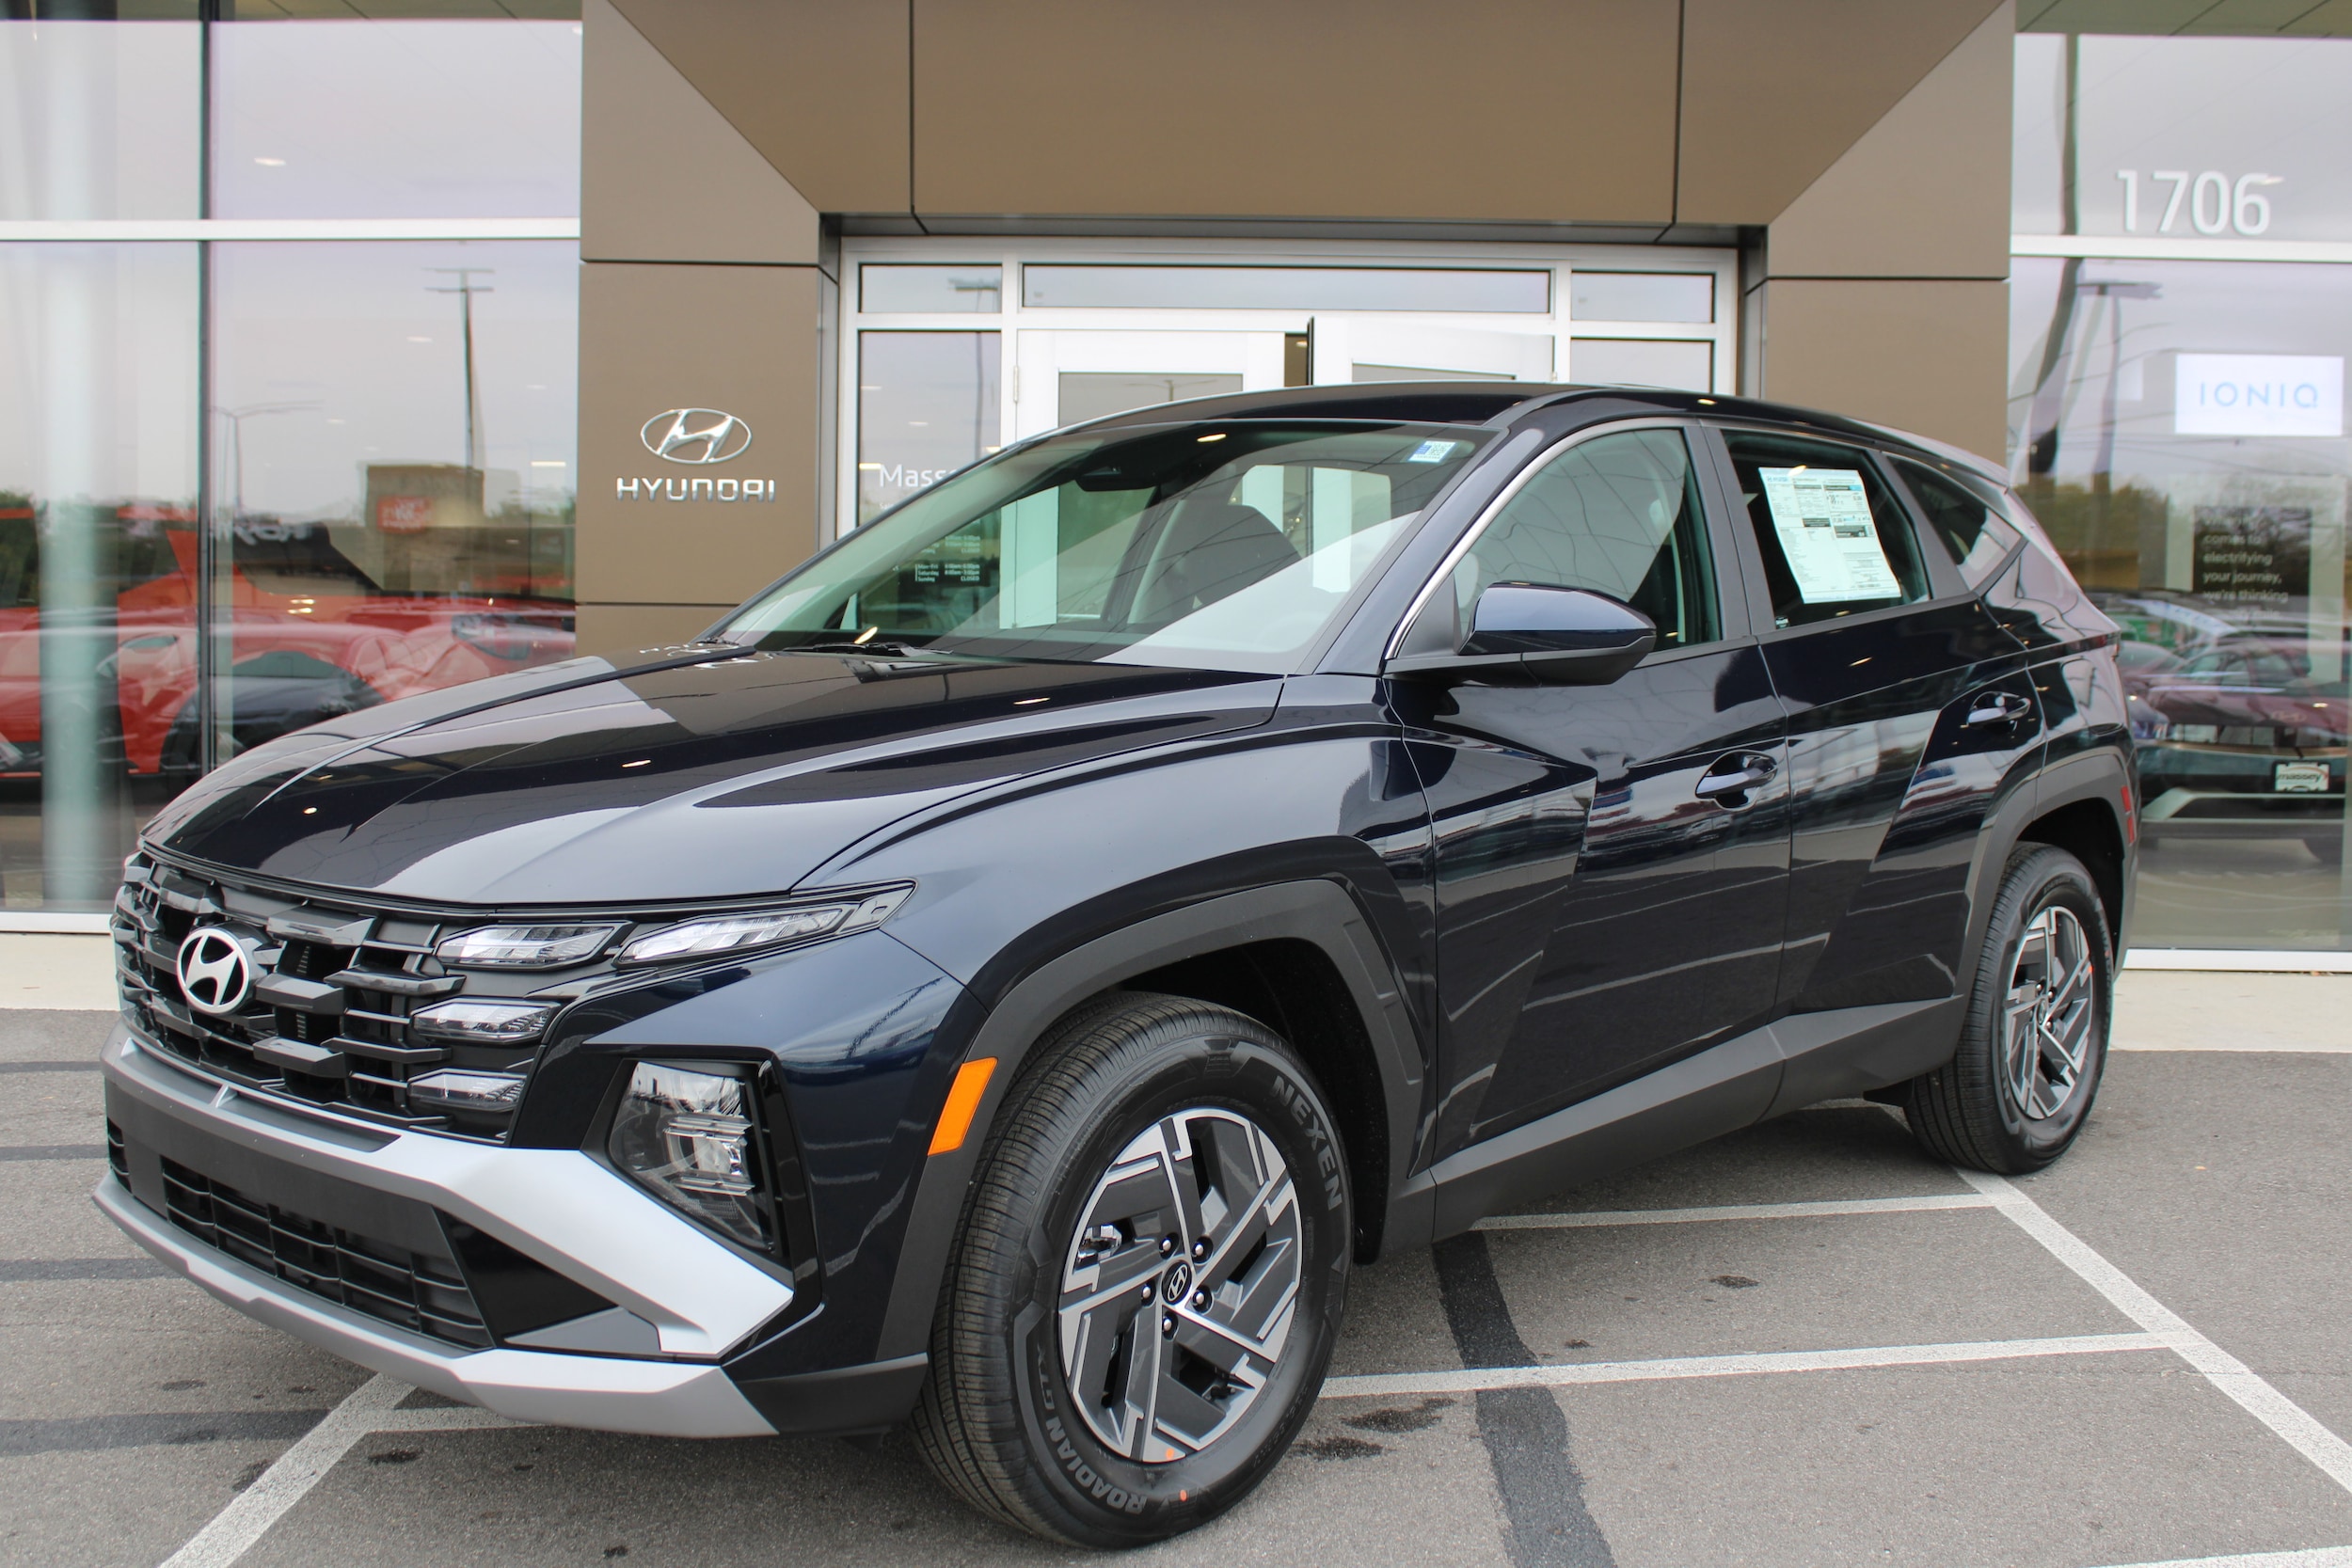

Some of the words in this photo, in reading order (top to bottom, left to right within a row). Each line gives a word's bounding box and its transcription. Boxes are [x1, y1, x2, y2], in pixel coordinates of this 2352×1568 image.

[2117, 168, 2271, 236] 1706
[2200, 381, 2320, 409] IONIQ
[880, 464, 958, 487] Mass
[616, 477, 775, 502] HYUNDAI
[2202, 551, 2273, 566] electrifying
[2202, 572, 2231, 584] your
[2238, 589, 2289, 603] thinking
[1271, 1075, 1343, 1212] NEXEN
[1045, 1416, 1147, 1515] ROADIAN
